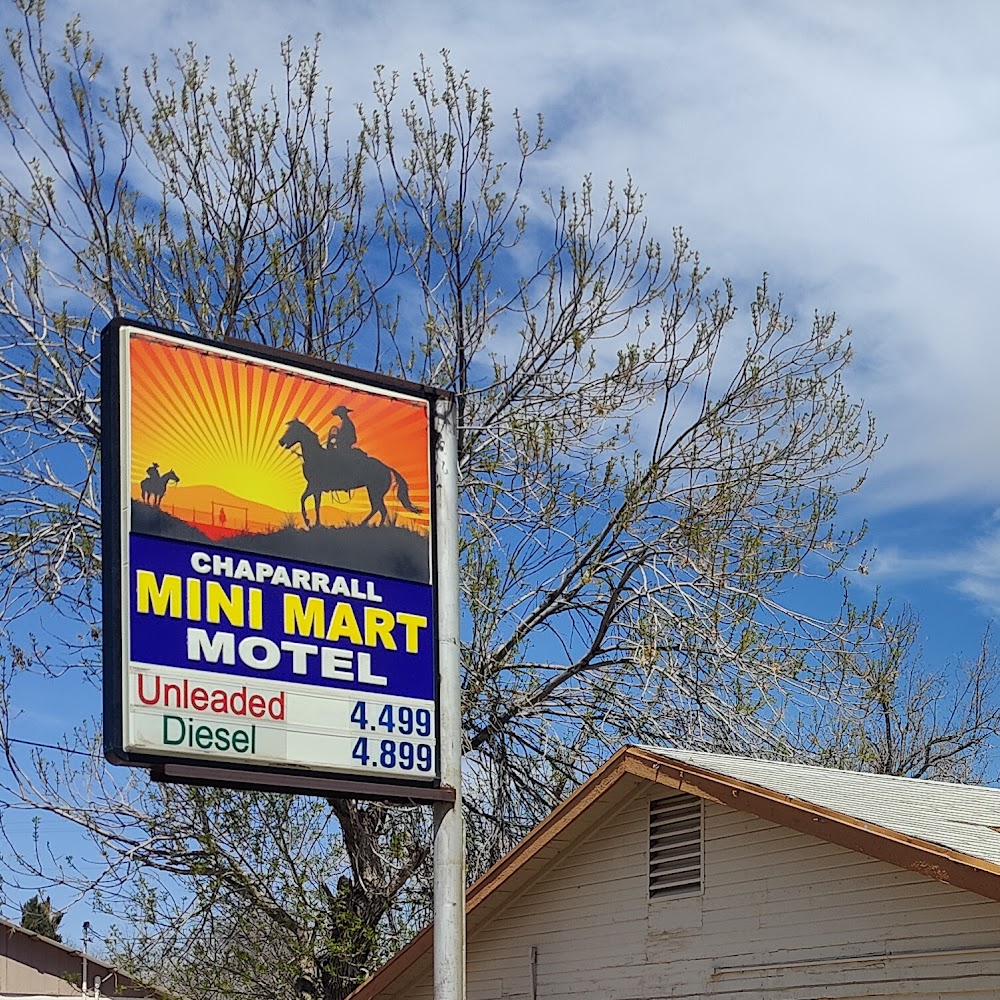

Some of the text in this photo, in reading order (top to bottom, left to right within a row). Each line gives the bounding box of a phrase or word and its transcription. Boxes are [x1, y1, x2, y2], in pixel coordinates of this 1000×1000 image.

[190, 551, 383, 603] CHAPARRALL
[136, 569, 428, 654] MINI MART
[187, 627, 388, 686] MOTEL
[138, 674, 431, 737] Unleaded 4.499
[163, 715, 432, 772] Diesel 4.899
